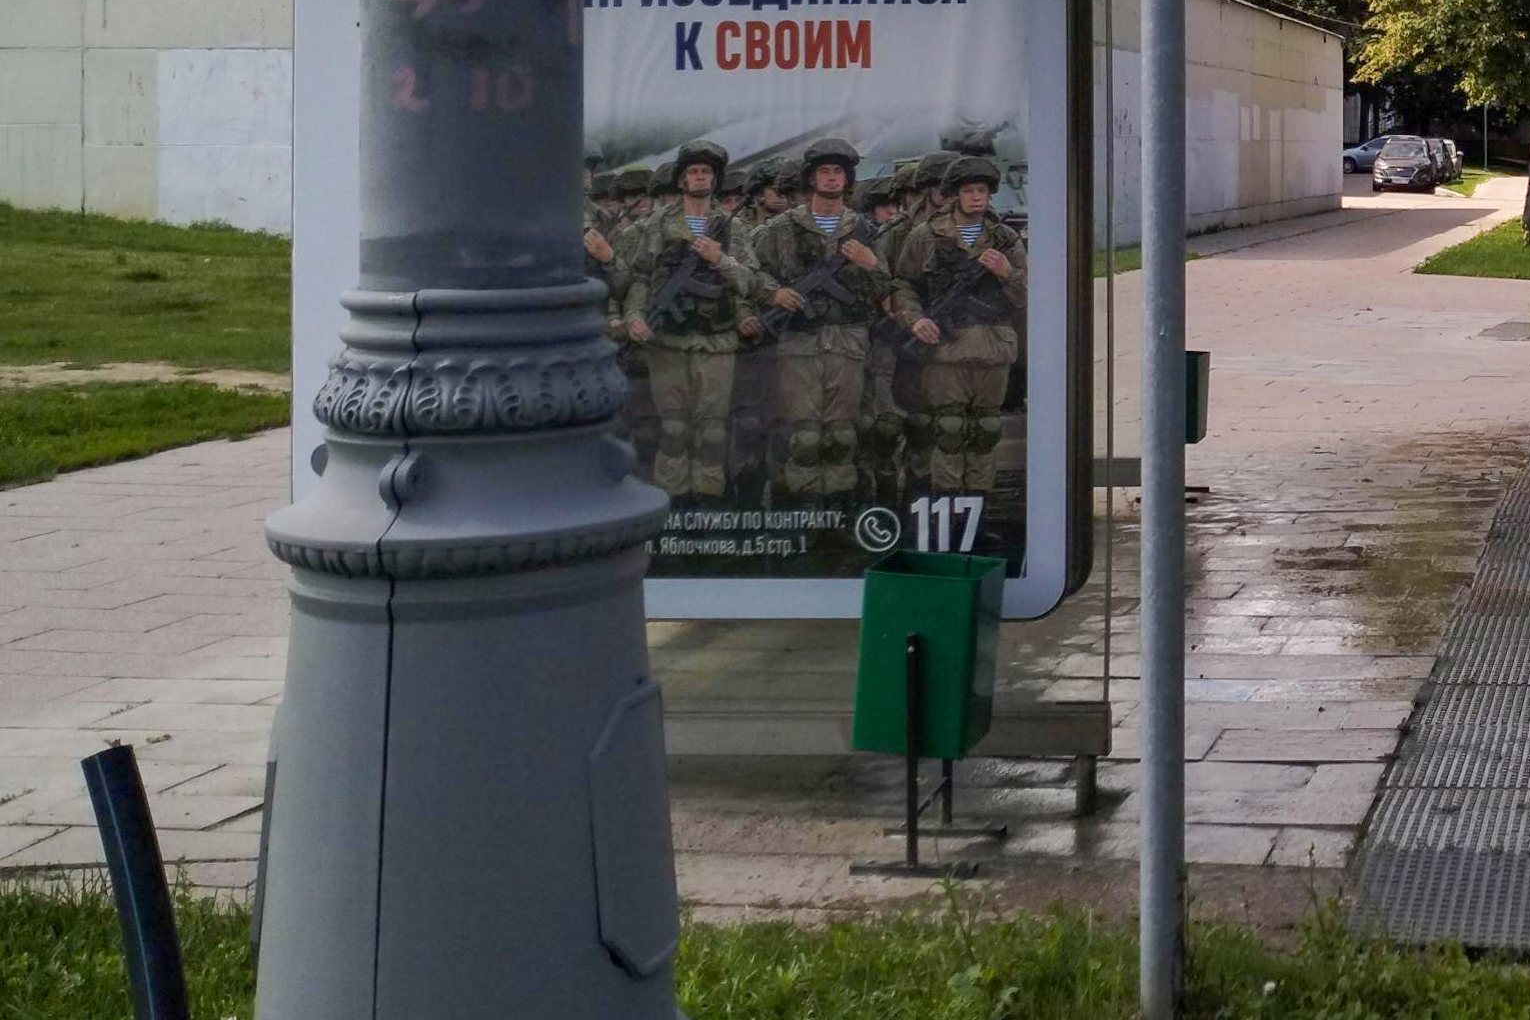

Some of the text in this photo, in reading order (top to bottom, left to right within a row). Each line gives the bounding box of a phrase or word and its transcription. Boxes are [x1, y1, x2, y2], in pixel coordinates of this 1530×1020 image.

[675, 19, 872, 71] К СВОИМ
[684, 511, 740, 530] СЛУЖБУ
[742, 511, 762, 530] ПО
[764, 509, 847, 530] КОНТРАКТУ:
[910, 496, 984, 552] 117
[644, 540, 656, 555] л.
[660, 536, 740, 557] Яблочкова,
